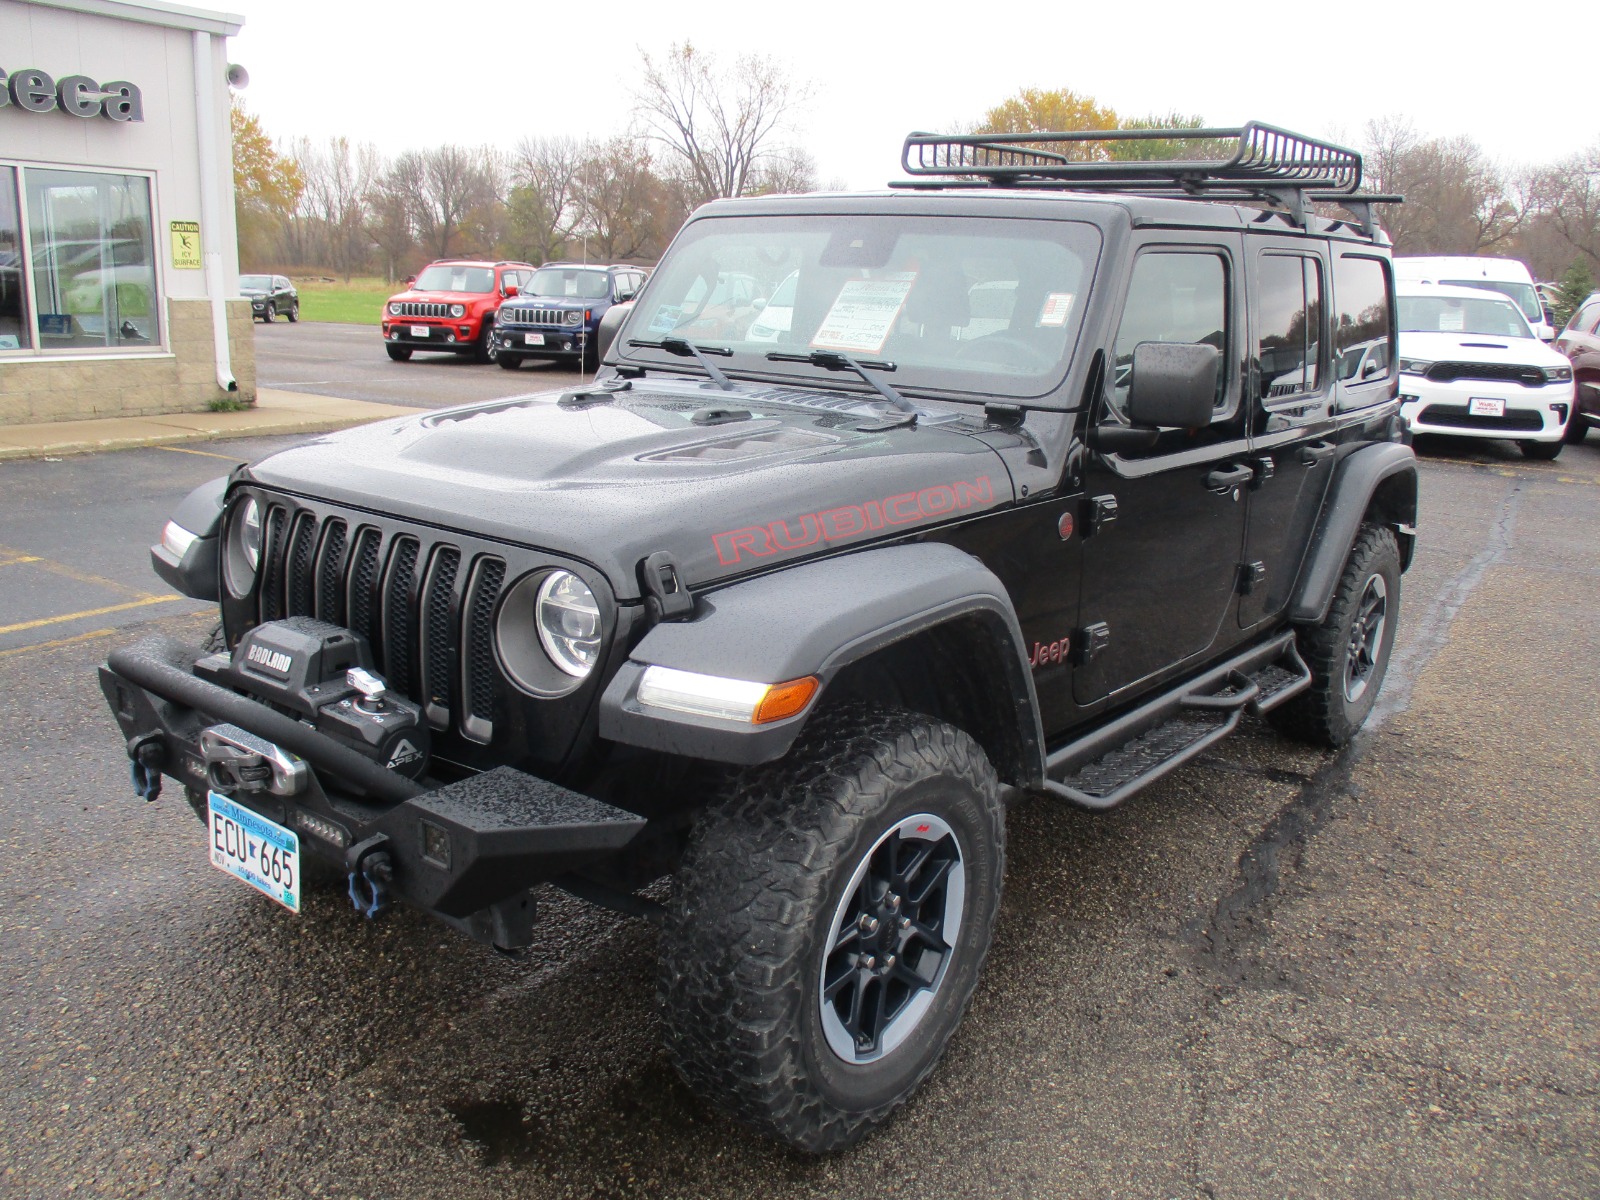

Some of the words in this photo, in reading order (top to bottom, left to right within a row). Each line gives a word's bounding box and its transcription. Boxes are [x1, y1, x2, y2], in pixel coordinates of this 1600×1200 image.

[0, 66, 144, 122] eca
[172, 223, 199, 232] CAUTION
[174, 258, 200, 266] SURFACE
[711, 476, 994, 566] RUBICON
[248, 644, 292, 673] BADLAND
[1028, 636, 1071, 669] Jeep
[385, 751, 424, 769] APEX
[214, 812, 247, 863] ECU
[260, 840, 293, 890] 665
